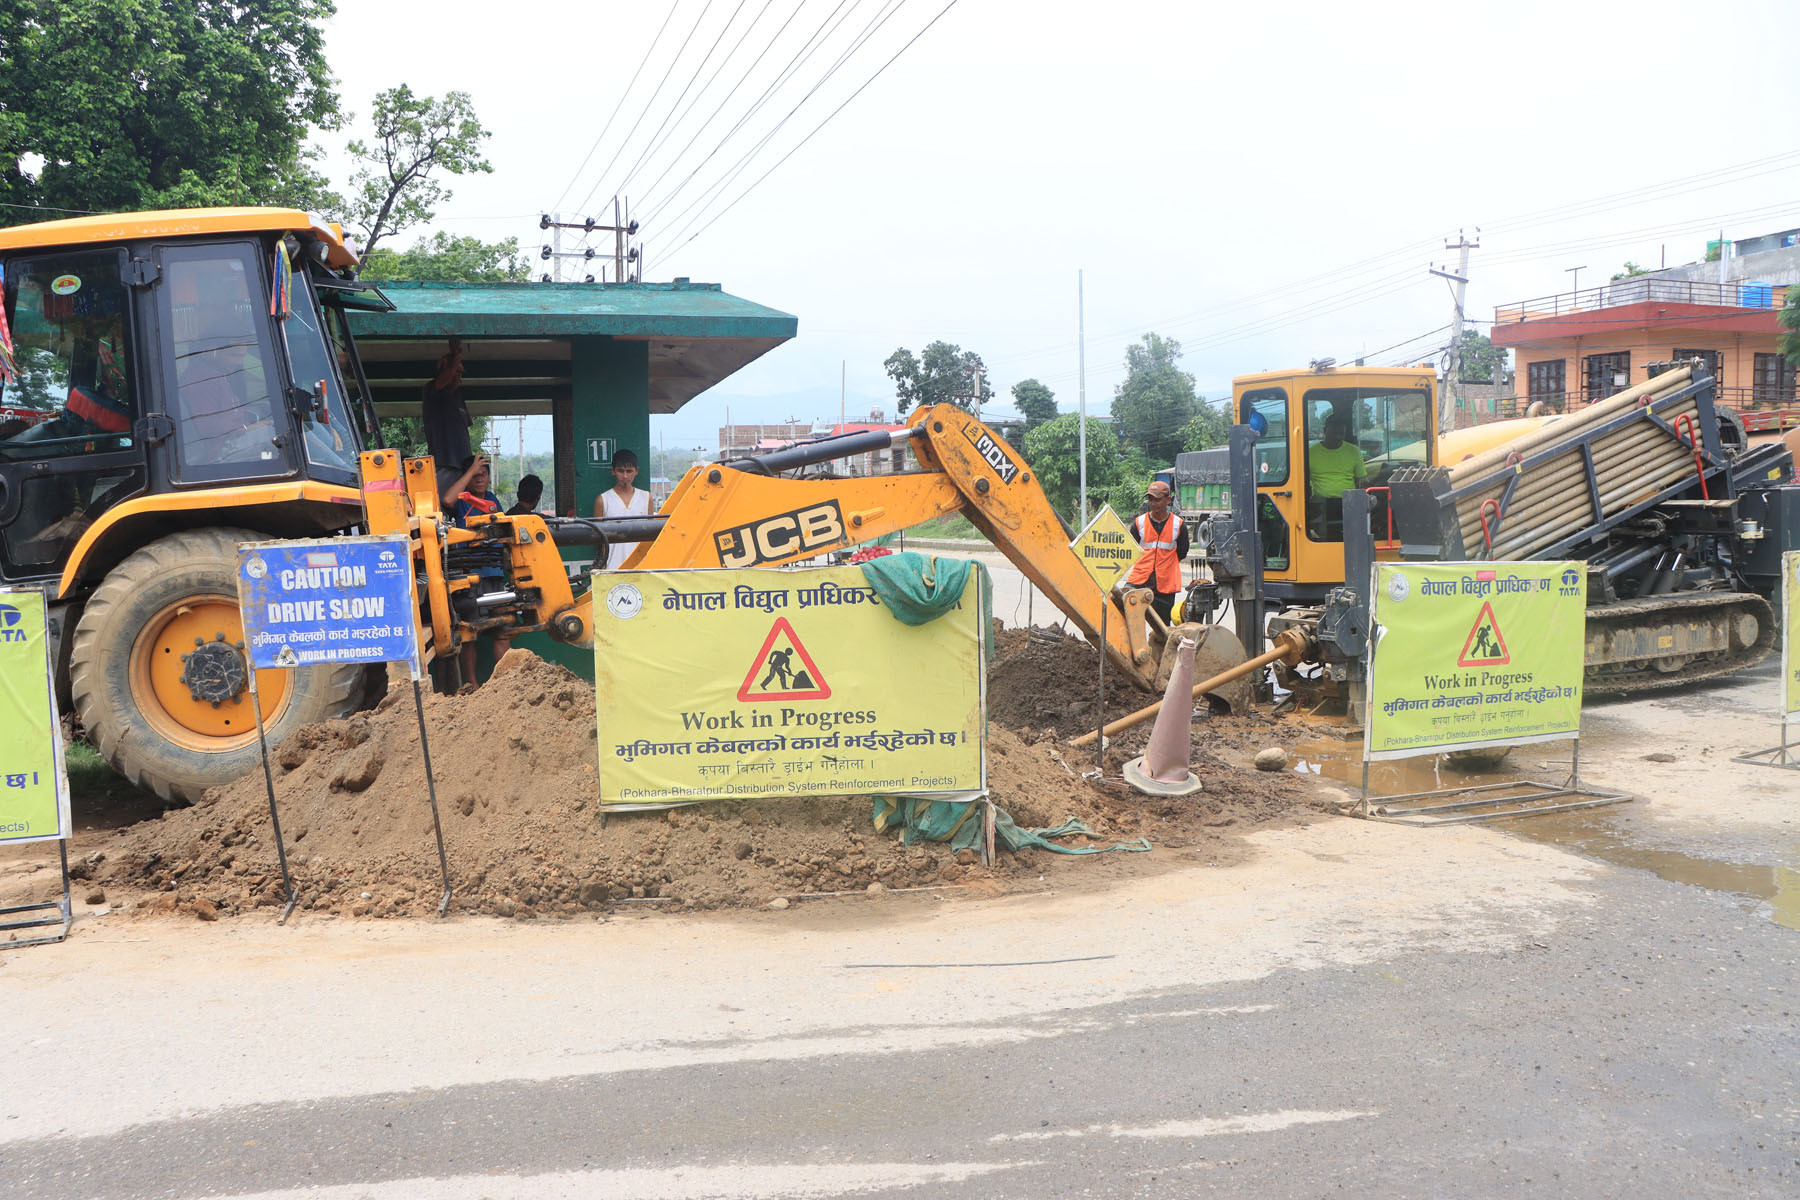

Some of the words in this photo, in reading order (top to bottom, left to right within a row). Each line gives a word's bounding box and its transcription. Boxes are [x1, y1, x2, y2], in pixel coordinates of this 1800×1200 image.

[590, 441, 608, 460] 11
[977, 435, 1014, 479] 3DX
[723, 505, 842, 568] JCB
[1092, 530, 1125, 544] Traffic
[1084, 546, 1132, 560] Diversion
[280, 566, 367, 590] CAUTION
[1421, 578, 1457, 596] नेपाल
[662, 588, 726, 610] नेपाल
[734, 585, 789, 614] विद्युत
[797, 582, 880, 610] प्राधिकर
[1559, 588, 1580, 596] TATA
[268, 600, 326, 624] DRIVE
[330, 597, 385, 620] SLOW
[0, 629, 27, 642] TA
[328, 628, 349, 640] कार्य
[298, 650, 326, 660] WORK
[327, 650, 336, 659] IN
[338, 646, 384, 658] PROGRESS
[1424, 674, 1461, 690] Work
[1464, 673, 1477, 687] in
[1481, 672, 1533, 689] Progress
[1384, 698, 1430, 716] भुमिगत
[1486, 689, 1513, 704] कार्य
[680, 710, 744, 730] Work
[752, 710, 773, 728] in
[780, 708, 877, 731] Progress
[1481, 728, 1503, 737] System
[615, 740, 692, 762] भुमिगत
[696, 734, 787, 754] केबलको
[792, 732, 840, 750] कार्य
[844, 729, 936, 751] भईरहेको
[698, 764, 730, 780] कृपया
[620, 786, 723, 800] (Pokhara-Bharatpur
[726, 784, 784, 794] Distribution
[788, 782, 826, 793] System
[830, 778, 905, 790] Reinforcement
[912, 776, 958, 788] Projects)
